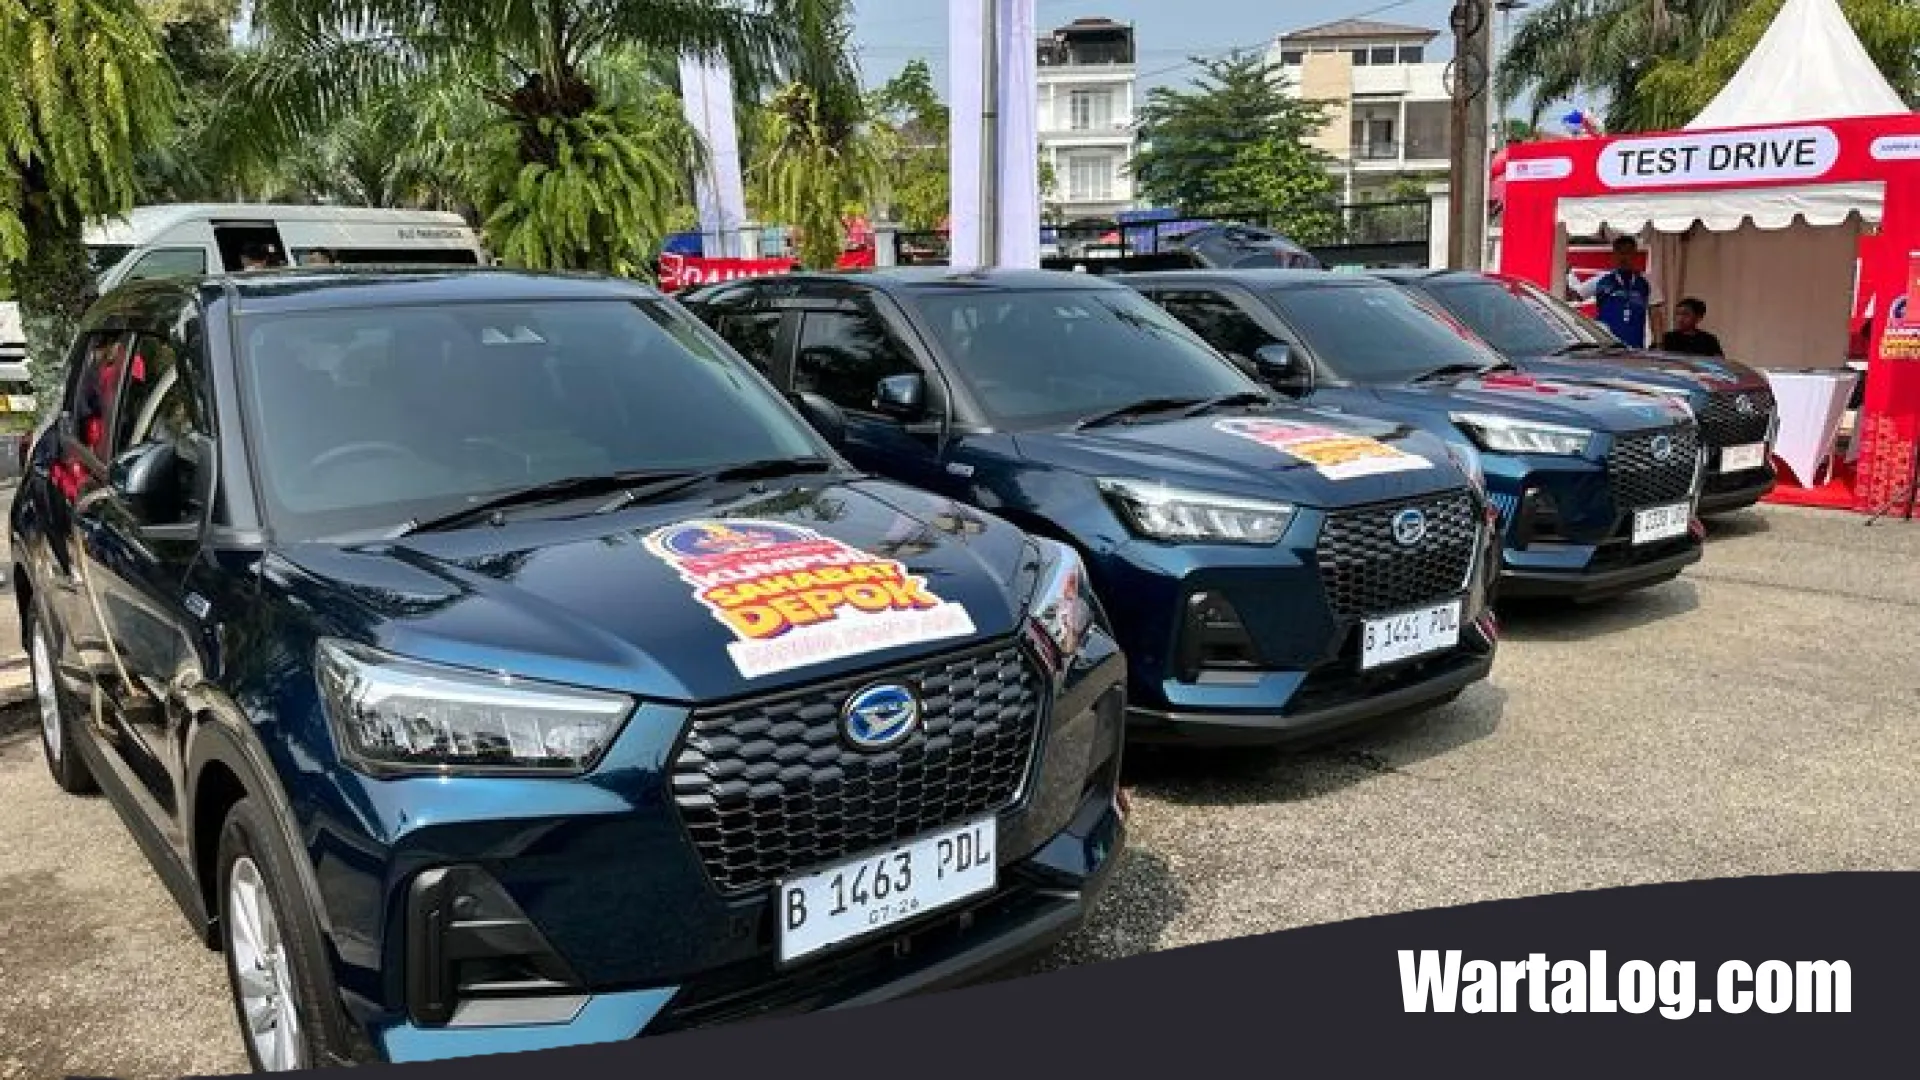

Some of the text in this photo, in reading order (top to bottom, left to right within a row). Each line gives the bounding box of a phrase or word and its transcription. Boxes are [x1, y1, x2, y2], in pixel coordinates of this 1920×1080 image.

[1618, 137, 1817, 176] TEST DRIVE
[702, 562, 902, 607] SAHABAT
[724, 577, 938, 639] DEPOK
[1365, 626, 1375, 651] B
[788, 828, 991, 932] B 1463 PDL
